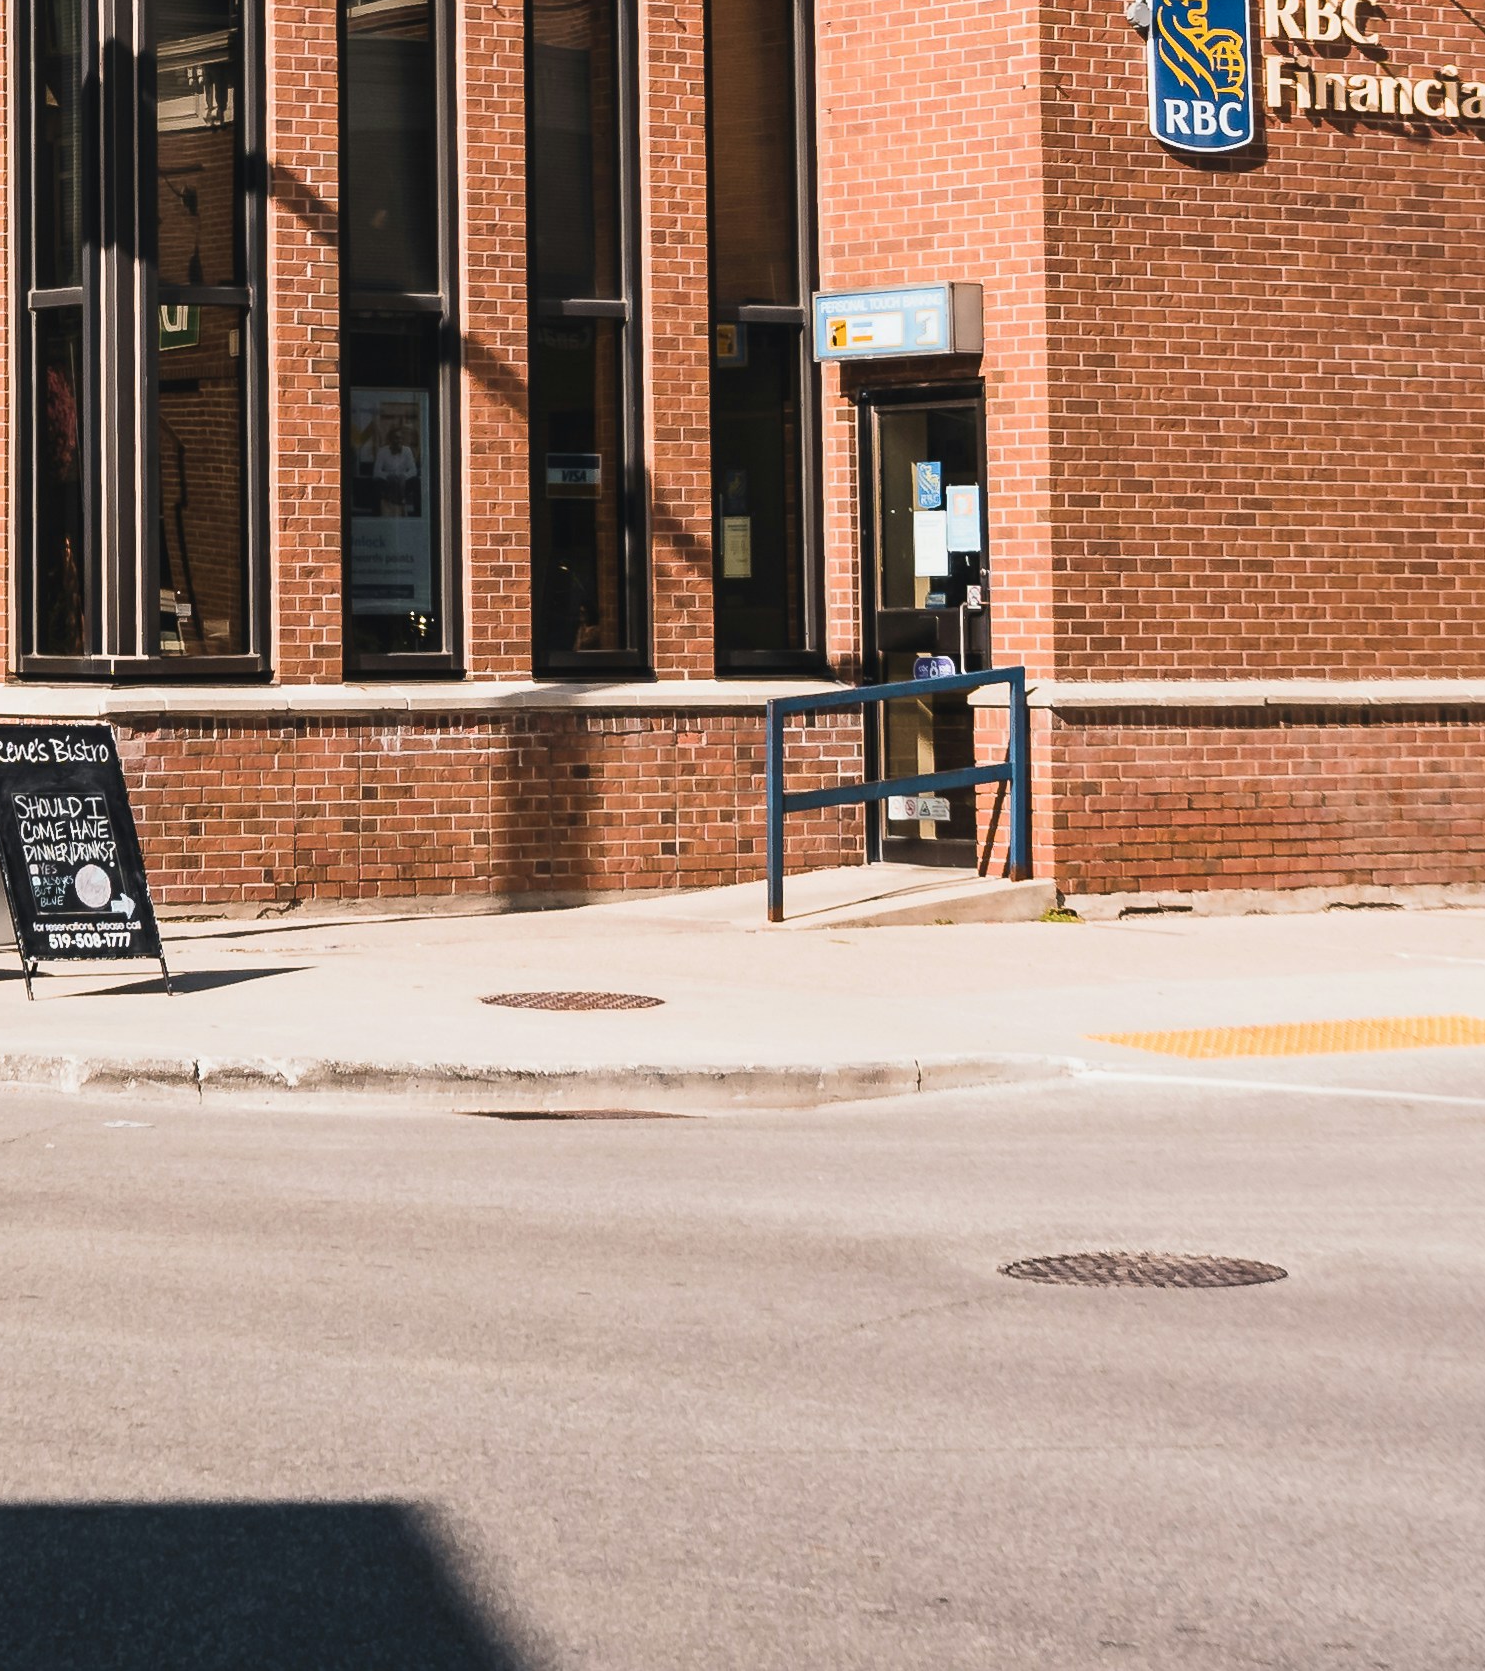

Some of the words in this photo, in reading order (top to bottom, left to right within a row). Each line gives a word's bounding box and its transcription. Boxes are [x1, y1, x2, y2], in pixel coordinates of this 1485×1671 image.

[1165, 99, 1243, 137] RBC
[820, 299, 868, 314] PERSONAL
[869, 296, 901, 311] TOUCH
[902, 292, 942, 308] BANKING
[562, 470, 587, 482] VISA
[48, 734, 109, 763] Bistro
[14, 795, 82, 819] SHOULD
[84, 797, 106, 819] I
[69, 819, 109, 840] HAVE
[39, 862, 57, 875] YES
[34, 886, 52, 898] BUT
[55, 887, 66, 895] IN
[41, 895, 64, 908] BLUE
[33, 922, 44, 932] for
[96, 923, 125, 932] please
[126, 921, 142, 930] call
[48, 932, 131, 949] 519-508-1777
